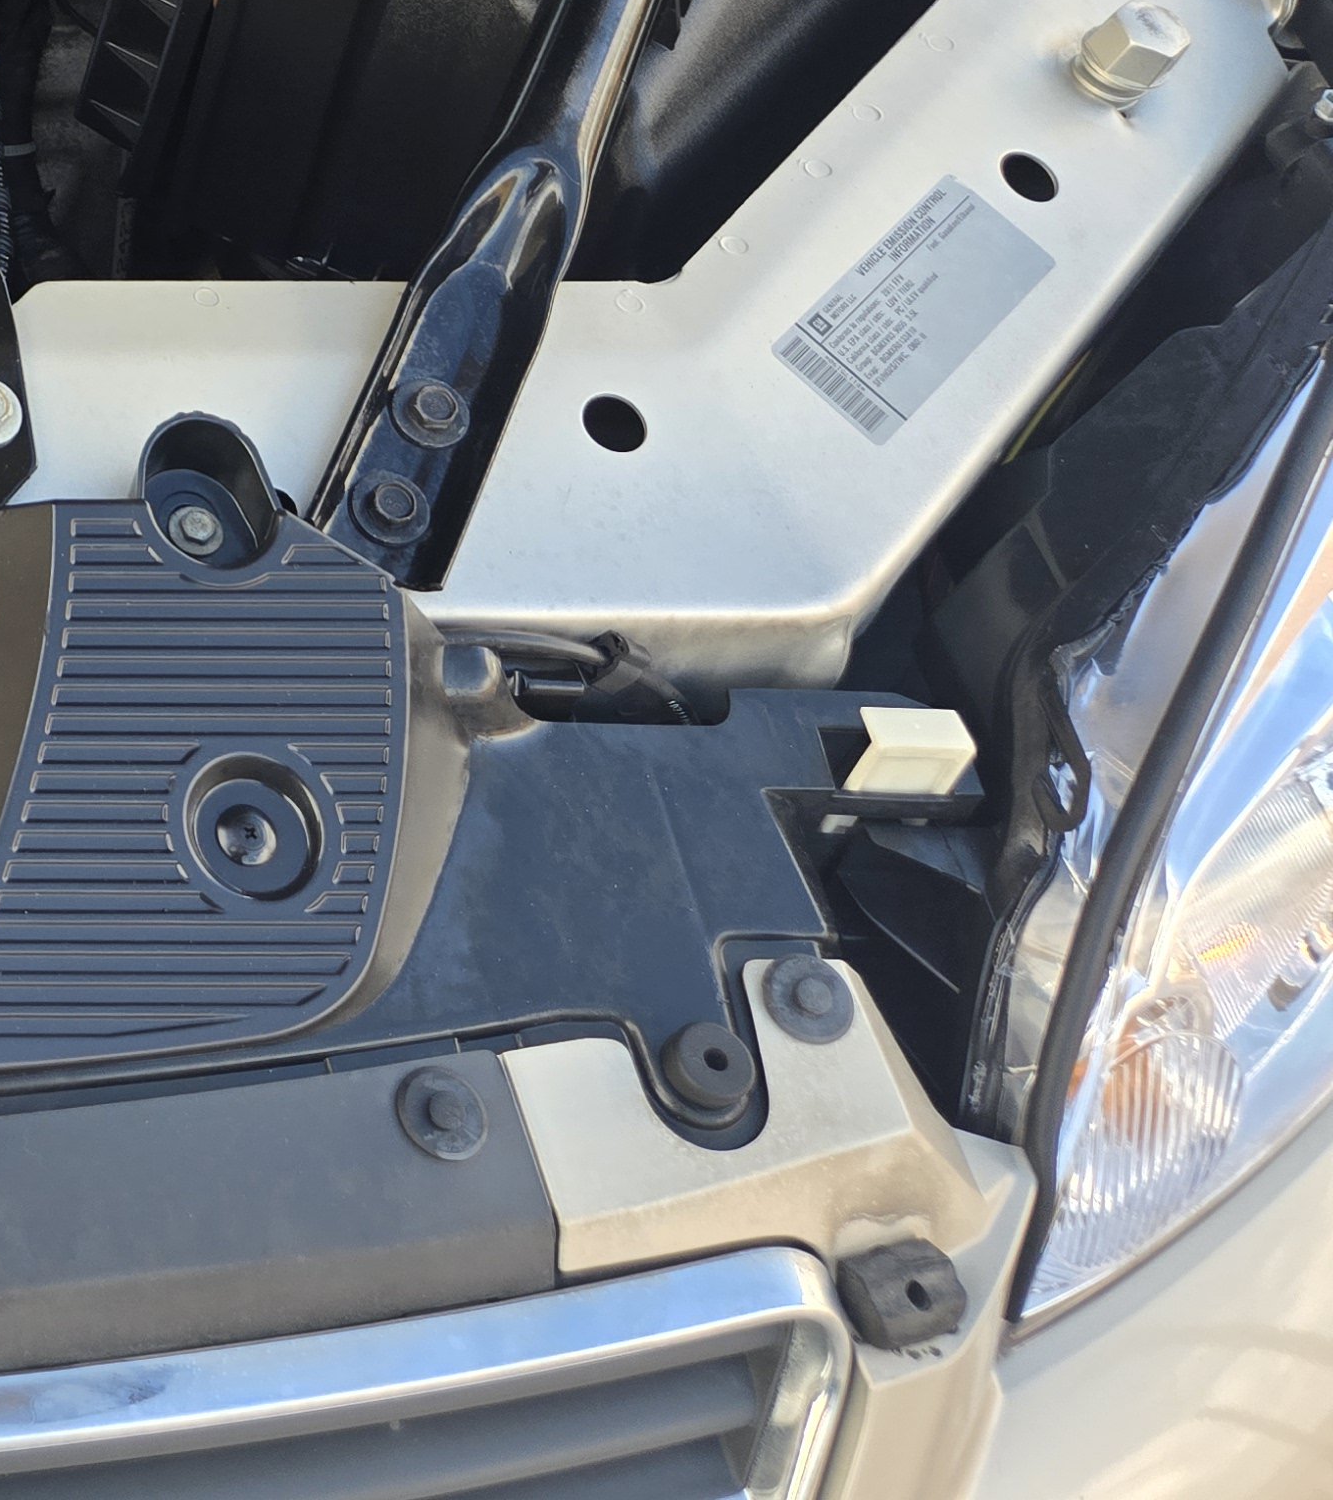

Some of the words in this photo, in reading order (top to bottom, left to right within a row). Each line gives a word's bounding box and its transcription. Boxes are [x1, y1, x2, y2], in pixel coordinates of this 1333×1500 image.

[855, 245, 886, 277] VEHICLE
[883, 216, 917, 250] EMISSION
[914, 186, 947, 220] CONTROL
[889, 215, 936, 263] INFORMATION
[847, 294, 857, 304] LLC
[838, 344, 850, 357] U.S.
[849, 335, 860, 346] EPA
[847, 341, 869, 364] California
[895, 306, 904, 315] PC
